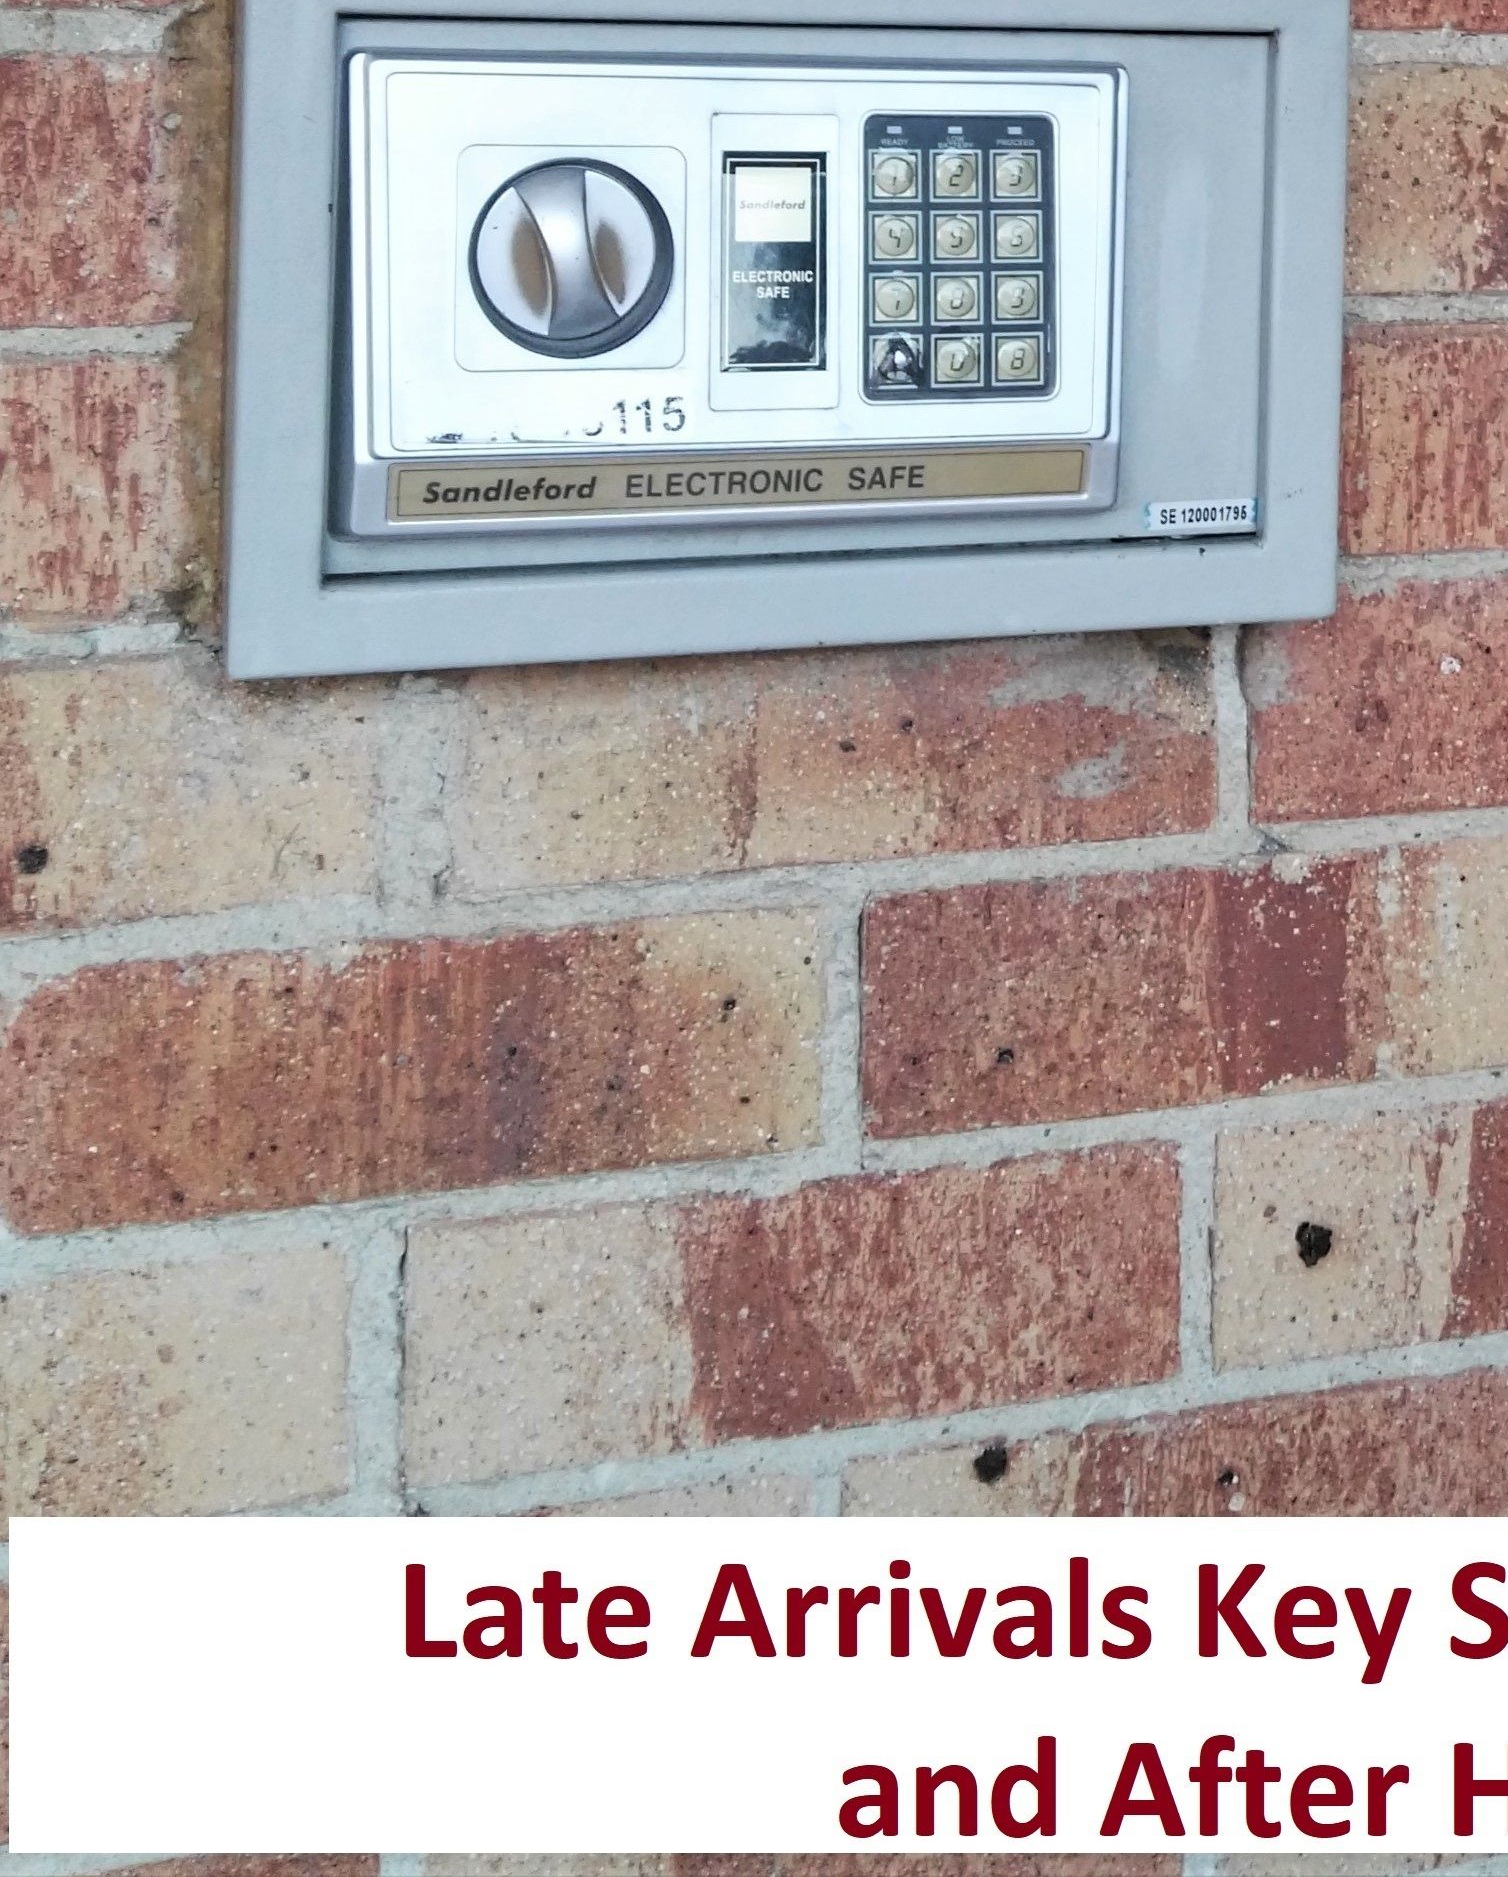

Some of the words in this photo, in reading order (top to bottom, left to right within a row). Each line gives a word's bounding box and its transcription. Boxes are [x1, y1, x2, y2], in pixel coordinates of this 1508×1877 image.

[950, 164, 964, 186] 2
[740, 199, 806, 210] Sandleford
[889, 228, 904, 249] 4
[732, 270, 814, 284] ELECTRONIC
[756, 286, 790, 299] SAFE
[423, 476, 597, 504] Sandleford
[626, 468, 823, 498] ELECTRONIC
[848, 465, 925, 491] SAFE
[1160, 509, 1176, 524] SE
